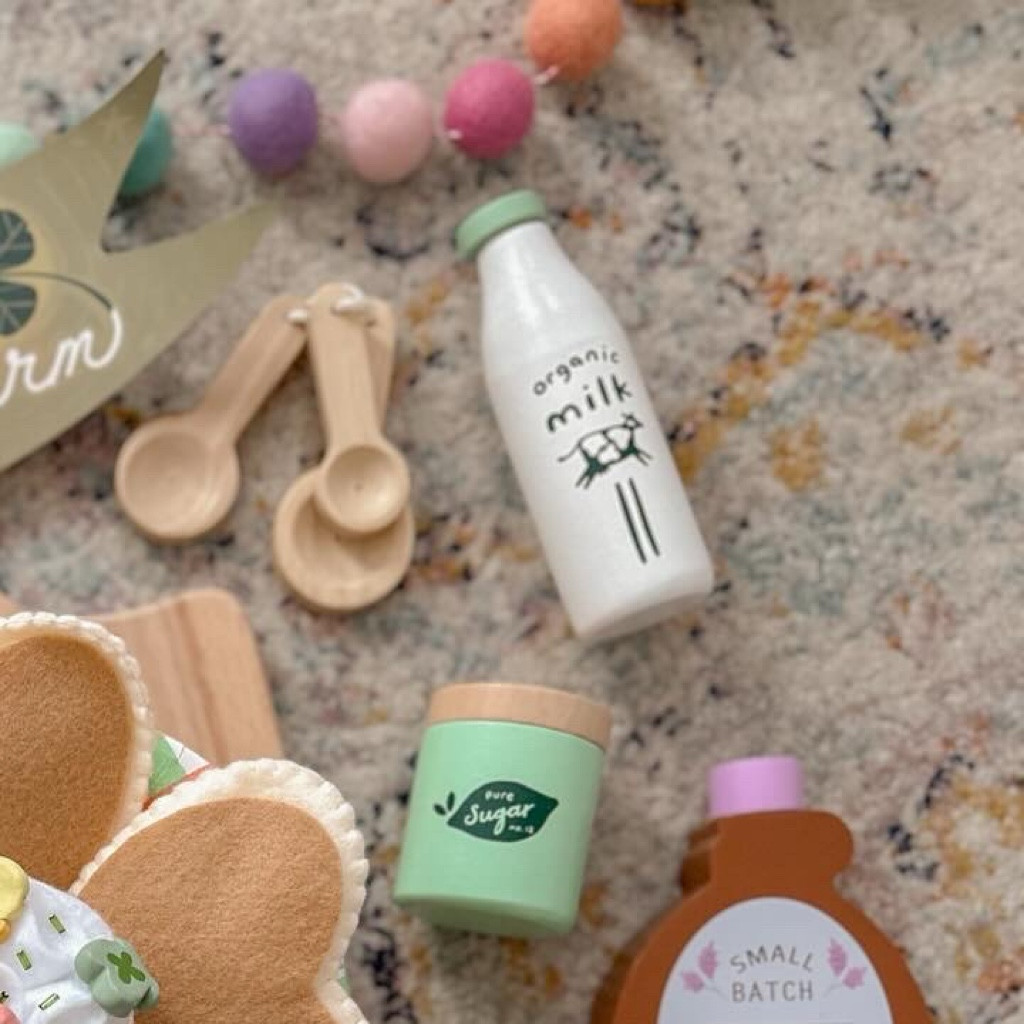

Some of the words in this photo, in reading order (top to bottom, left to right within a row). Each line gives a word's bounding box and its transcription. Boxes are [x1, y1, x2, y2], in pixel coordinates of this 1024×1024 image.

[533, 344, 619, 395] organic
[547, 374, 632, 433] milk
[464, 803, 535, 835] Sugar
[730, 945, 814, 974] SMALL
[731, 980, 813, 1002] BATCH
